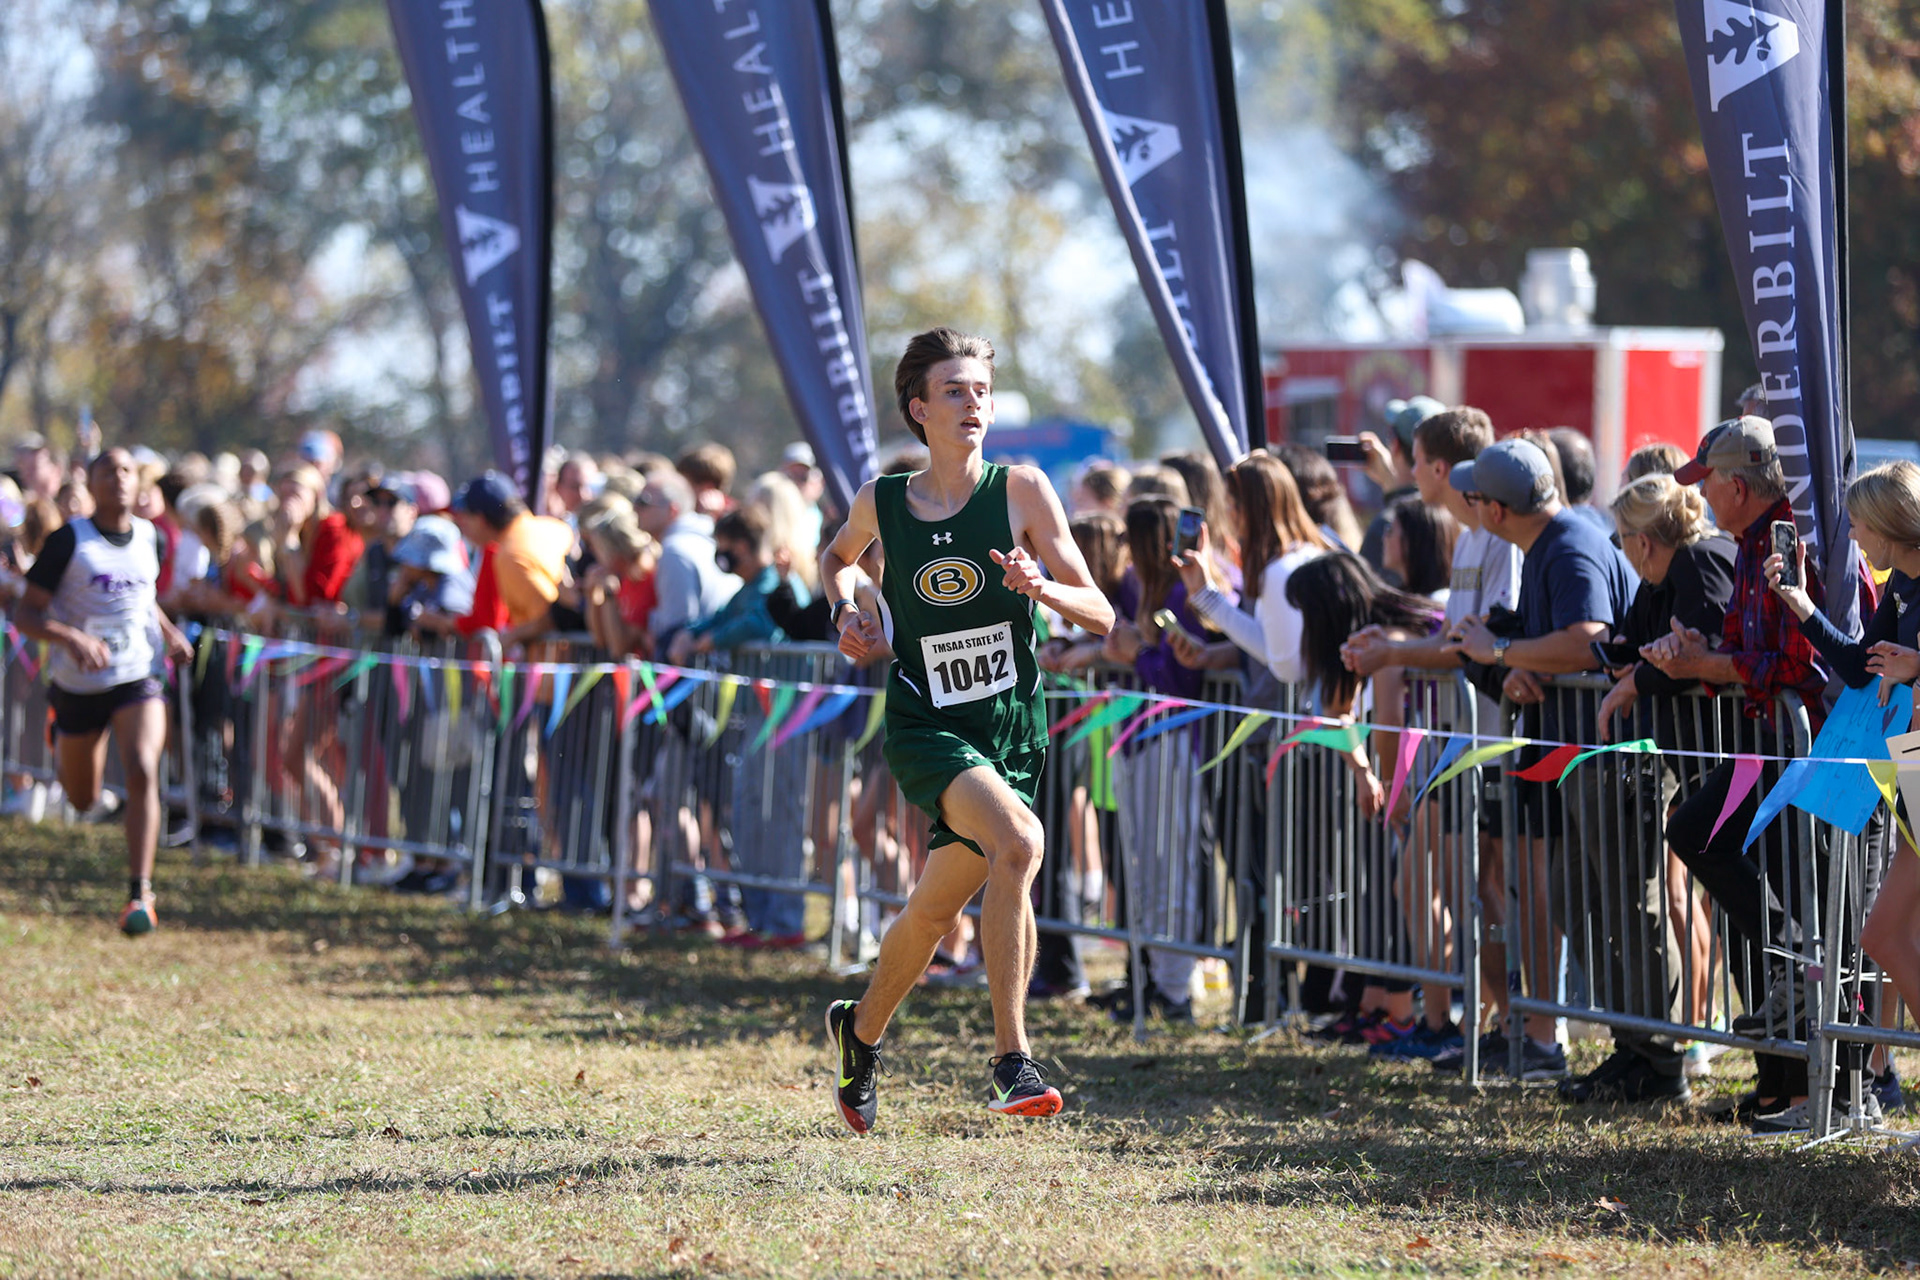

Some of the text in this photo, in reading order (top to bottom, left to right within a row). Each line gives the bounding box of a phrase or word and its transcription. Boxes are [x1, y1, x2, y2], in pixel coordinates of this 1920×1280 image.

[440, 0, 500, 193] HEALTH
[932, 631, 1005, 654] TMSAA STATE XC
[933, 649, 1009, 694] 1042
